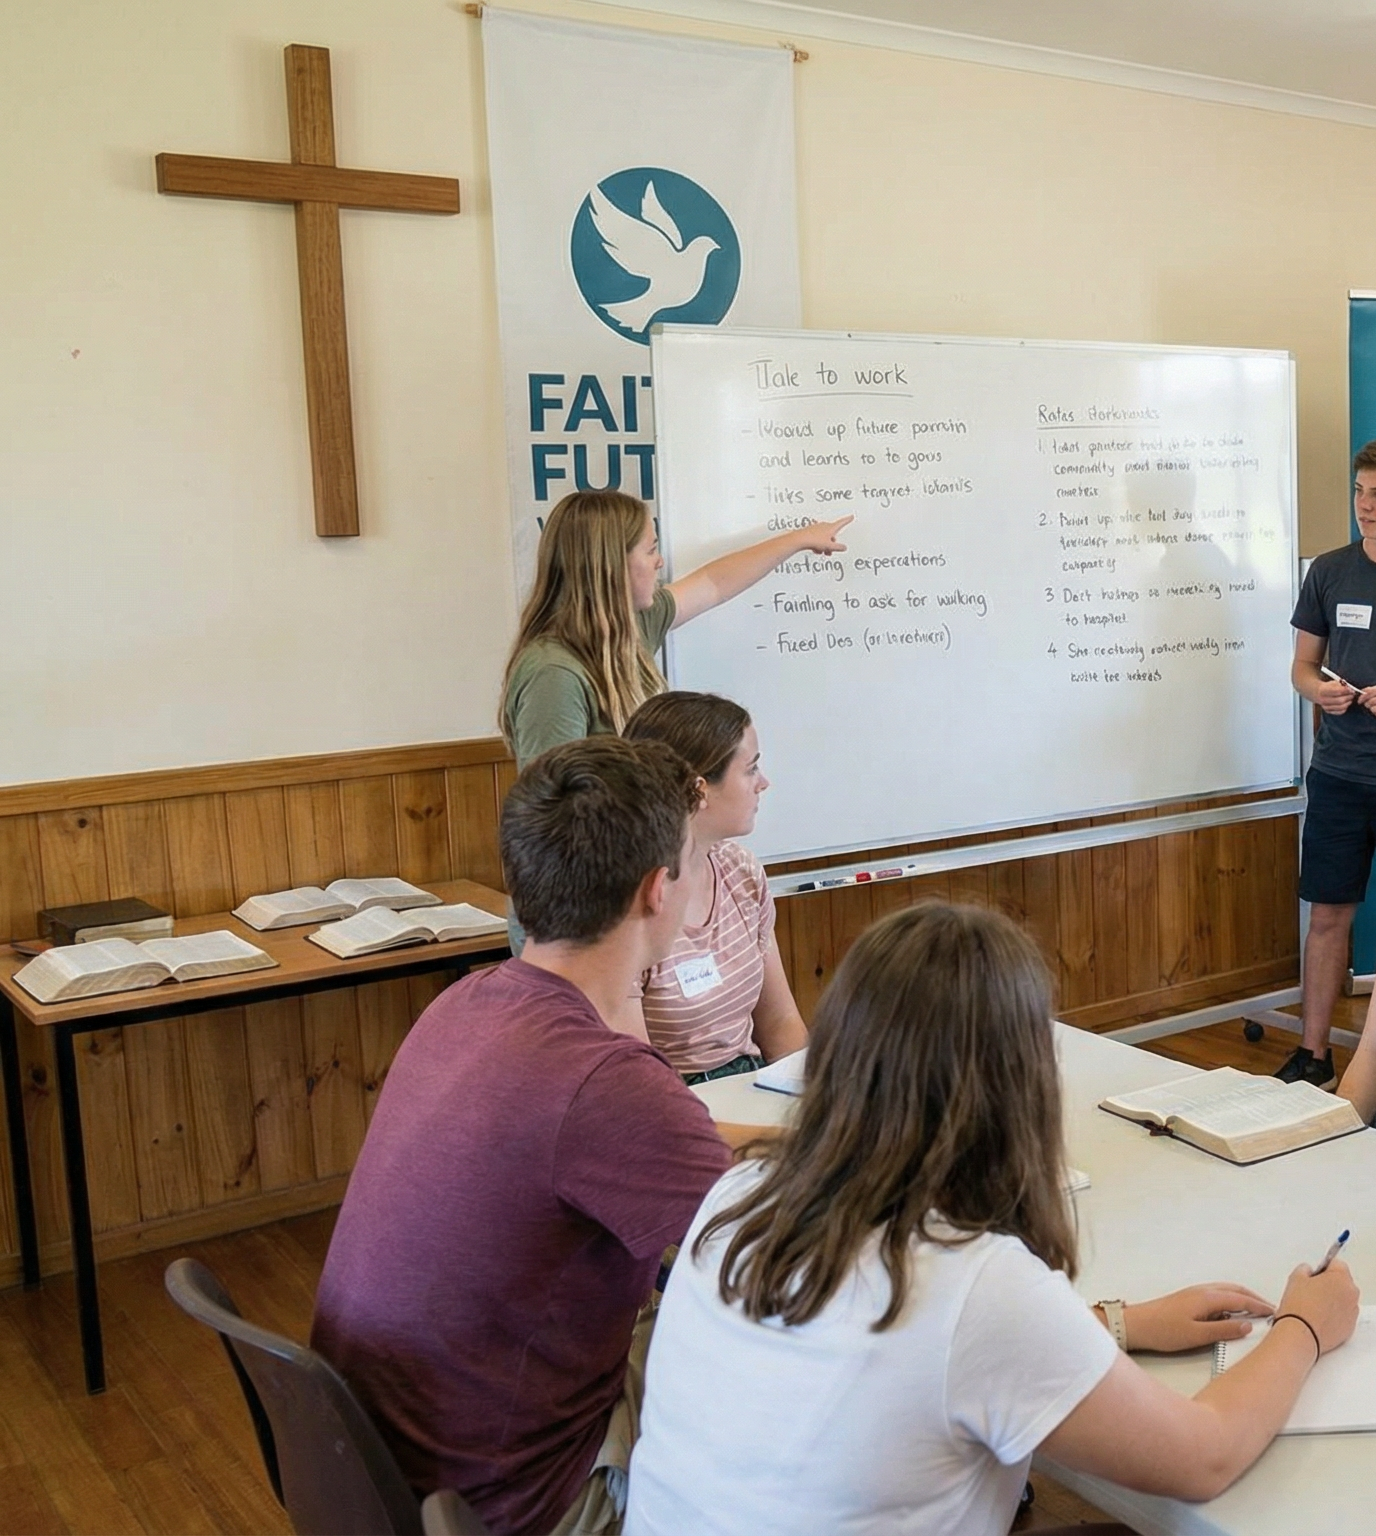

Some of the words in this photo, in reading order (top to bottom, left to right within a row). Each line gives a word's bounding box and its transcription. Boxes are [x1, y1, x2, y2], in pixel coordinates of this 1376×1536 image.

[816, 362, 838, 385] to
[854, 363, 908, 385] work
[528, 373, 652, 432] FAI
[827, 424, 846, 442] up
[759, 450, 791, 468] and
[815, 489, 854, 503] some
[842, 592, 861, 609] to
[905, 589, 928, 608] for
